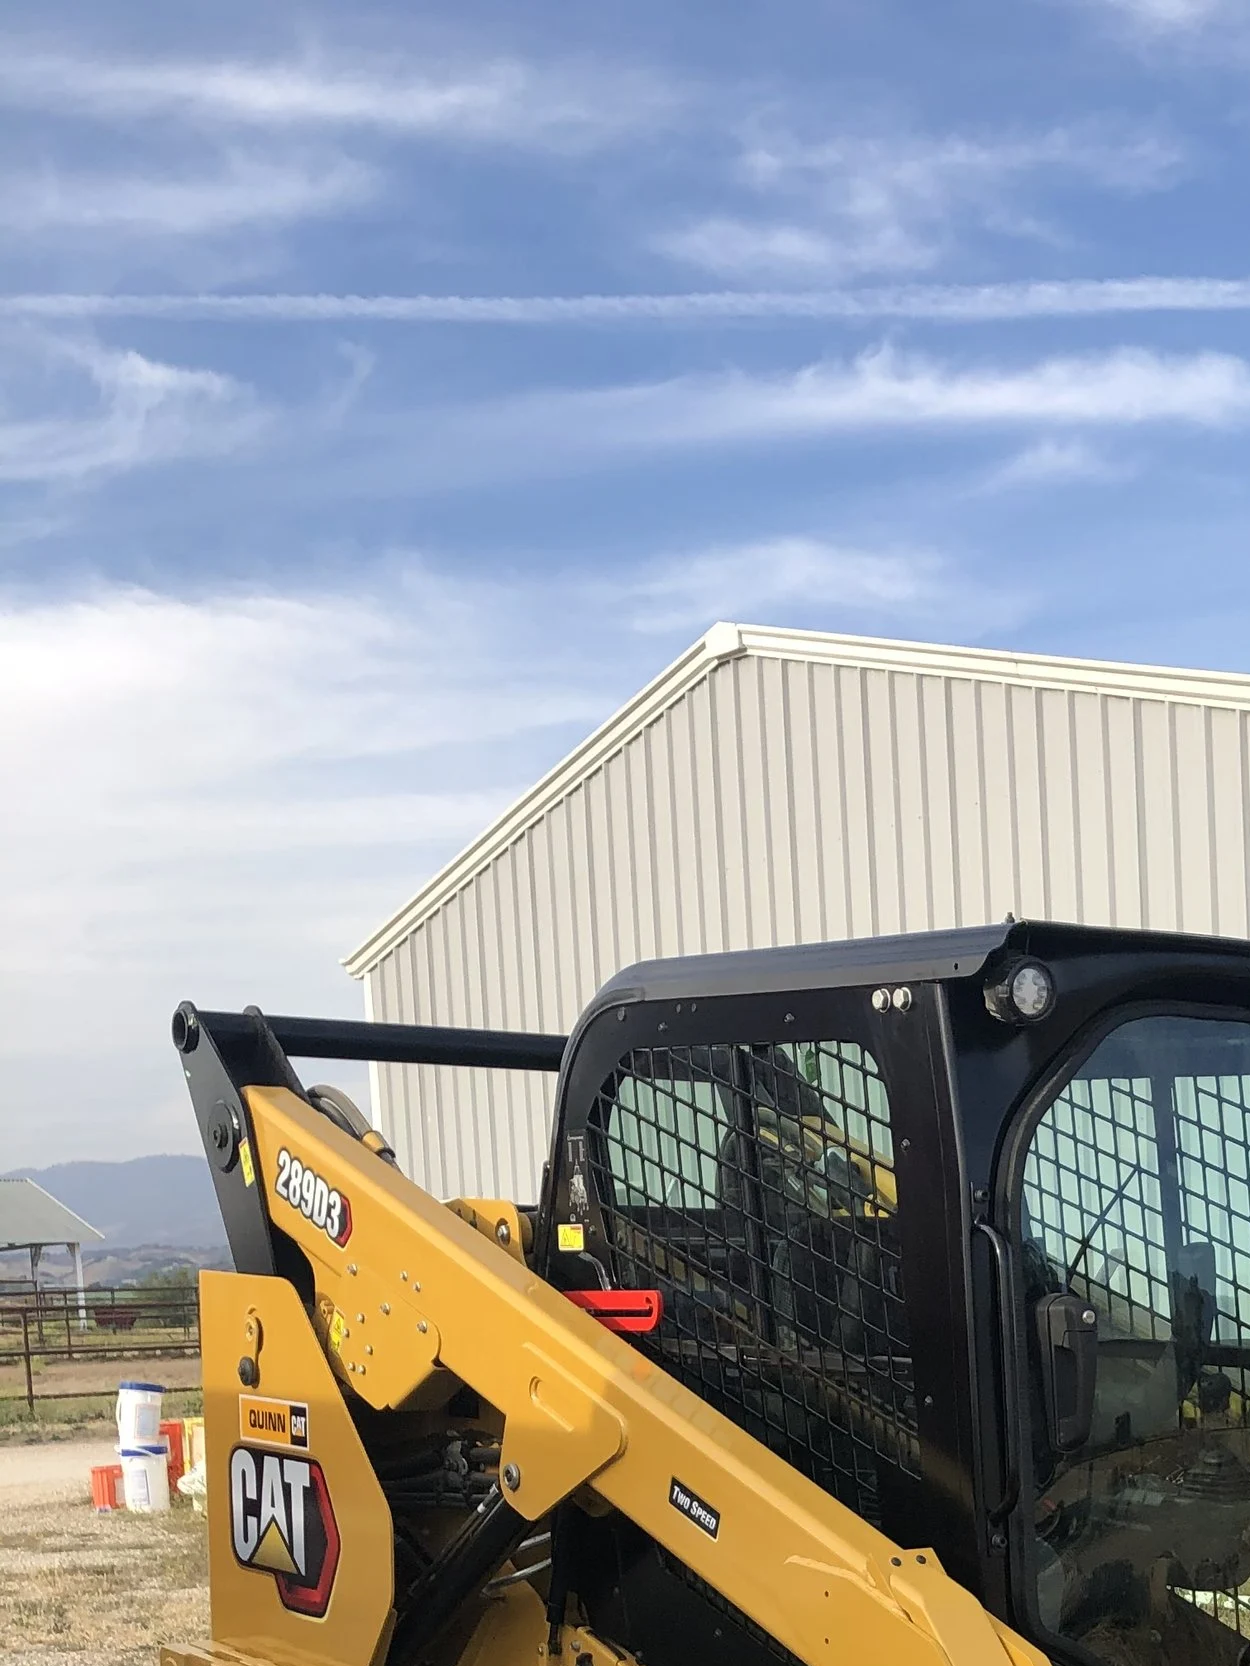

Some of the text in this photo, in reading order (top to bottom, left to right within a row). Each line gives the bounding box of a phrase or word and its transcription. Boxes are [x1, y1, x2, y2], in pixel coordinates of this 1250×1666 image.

[276, 1149, 341, 1238] 289D3
[249, 1408, 307, 1438] QUINN CAT
[230, 1448, 310, 1577] CAT
